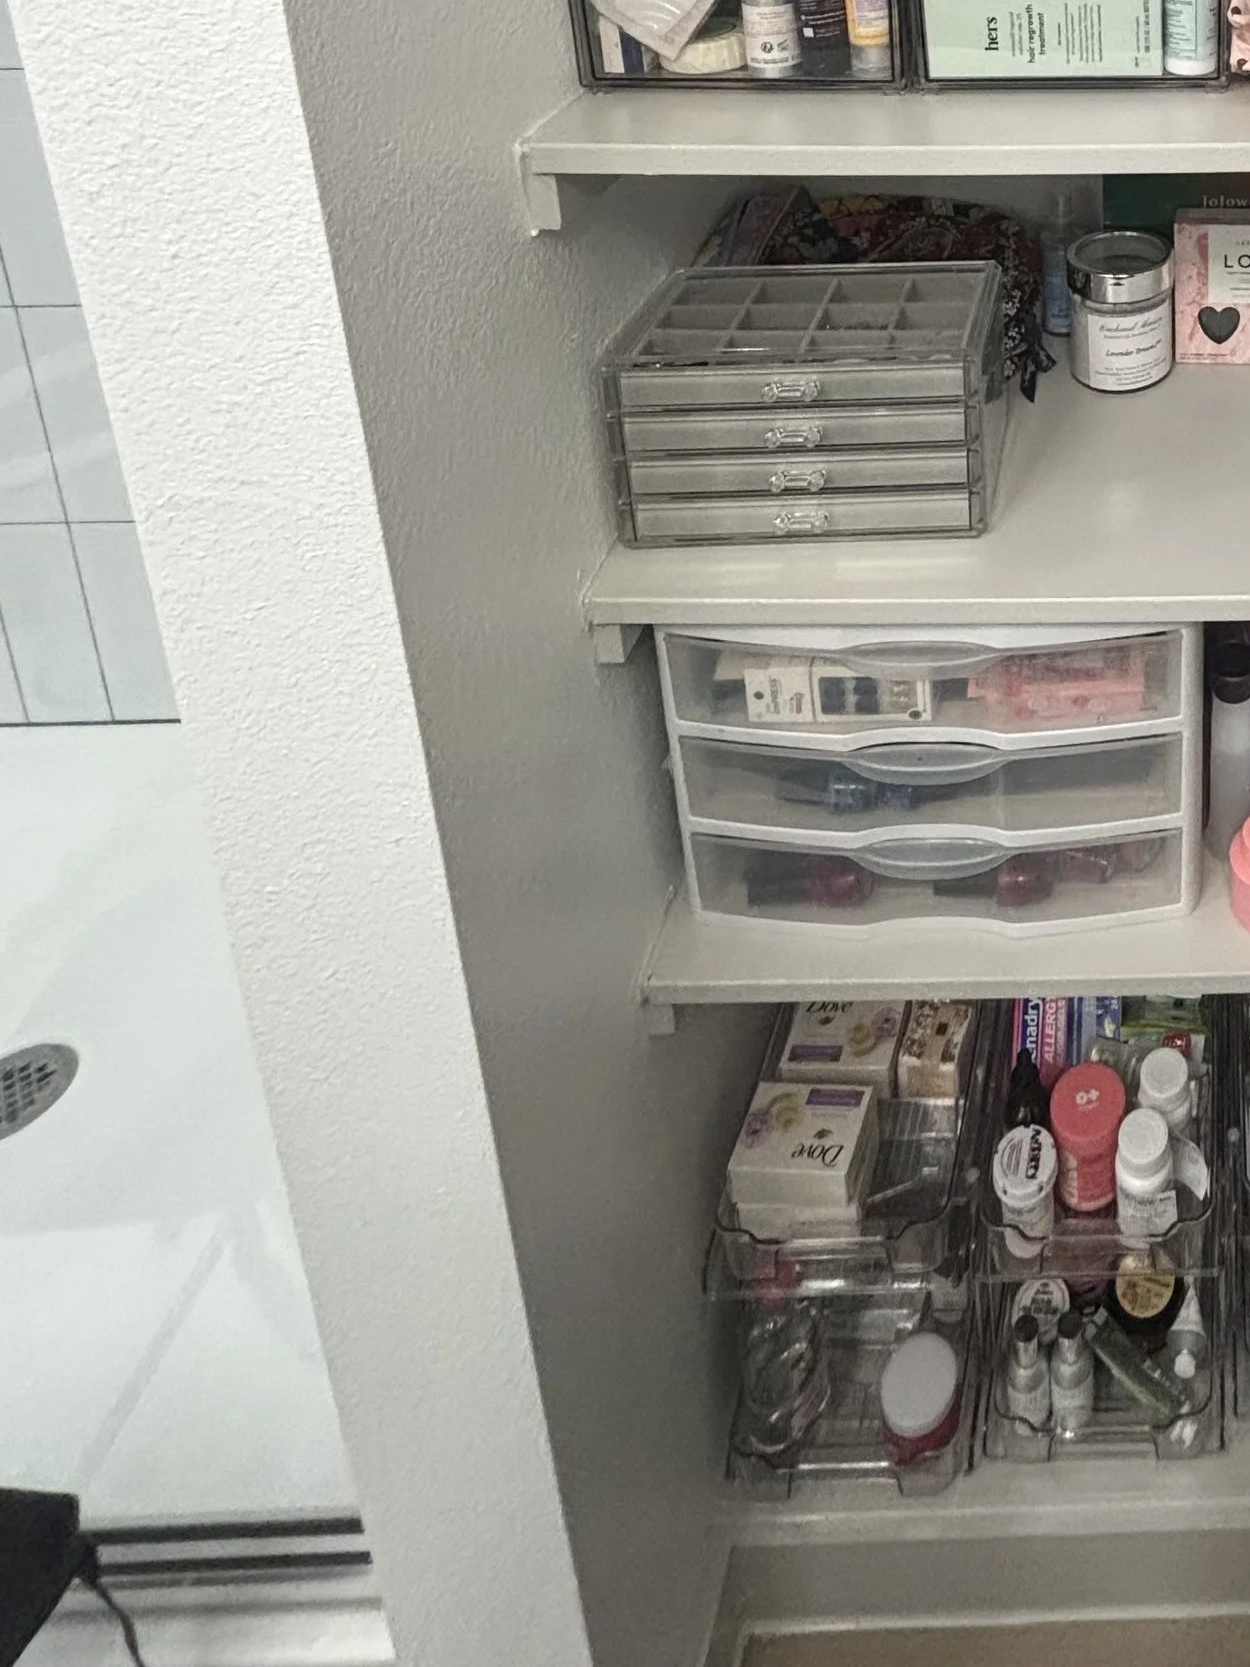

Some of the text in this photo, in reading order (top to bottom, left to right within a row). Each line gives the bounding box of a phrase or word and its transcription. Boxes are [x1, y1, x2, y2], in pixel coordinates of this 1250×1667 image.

[985, 16, 999, 51] hers
[1025, 4, 1036, 63] hair regrowth
[1037, 12, 1047, 55] treatment
[791, 1142, 844, 1167] Dove
